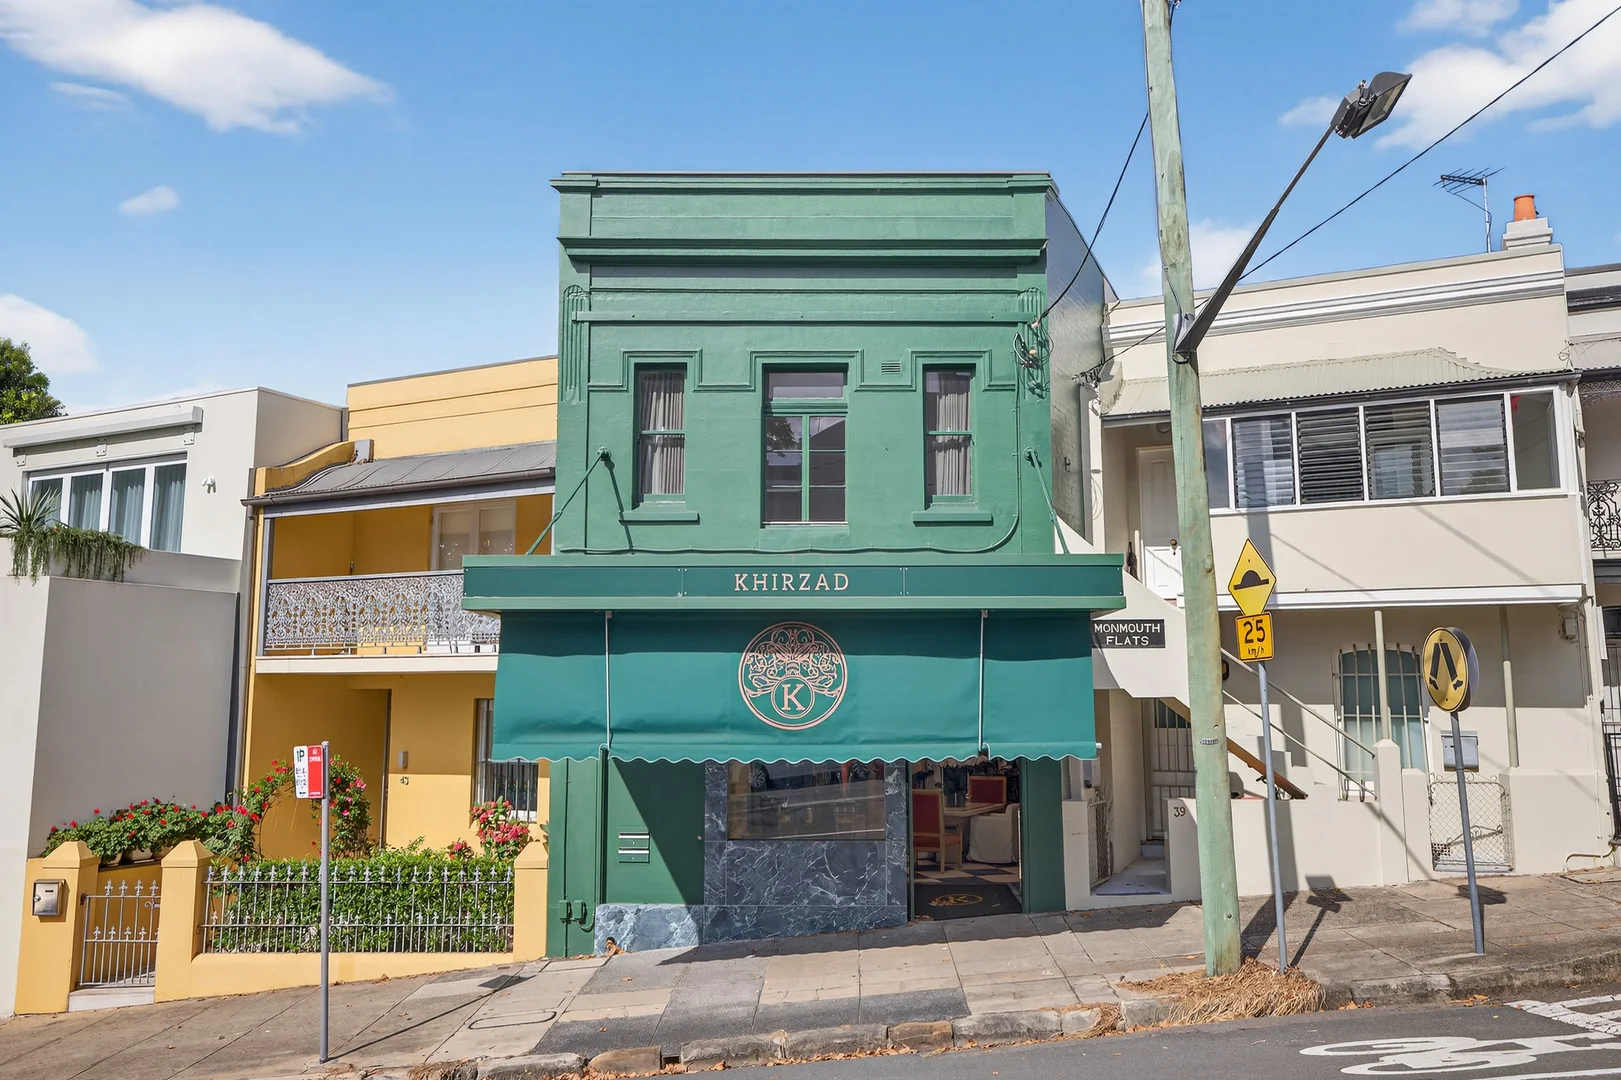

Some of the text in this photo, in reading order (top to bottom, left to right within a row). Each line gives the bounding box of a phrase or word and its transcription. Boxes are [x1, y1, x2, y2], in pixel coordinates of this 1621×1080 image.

[734, 573, 849, 591] KHIRZAD
[1094, 623, 1160, 633] MONMOUTH
[1243, 619, 1266, 644] 25
[1106, 636, 1149, 646] FLATS
[781, 683, 806, 711] K
[1173, 806, 1186, 817] 39
